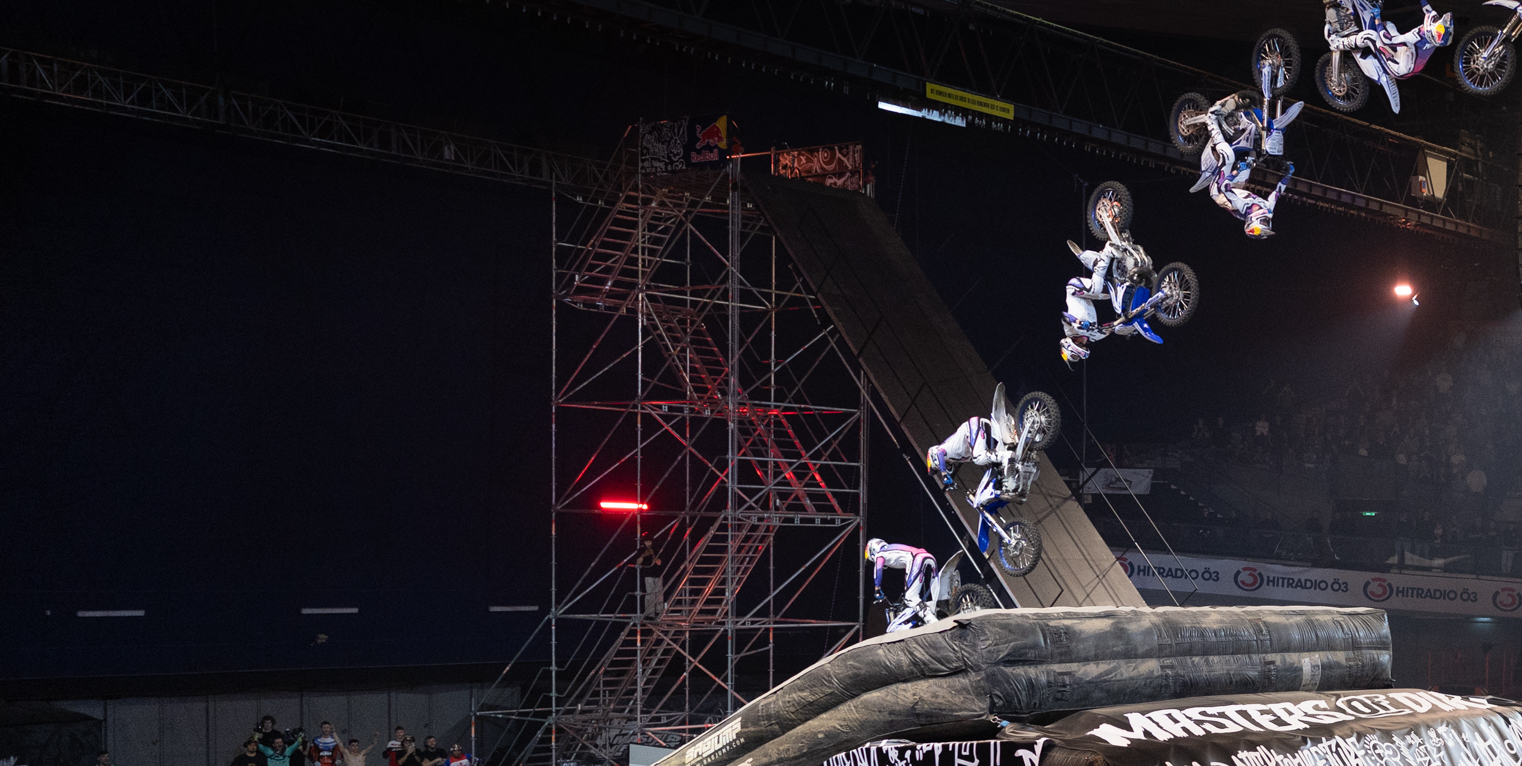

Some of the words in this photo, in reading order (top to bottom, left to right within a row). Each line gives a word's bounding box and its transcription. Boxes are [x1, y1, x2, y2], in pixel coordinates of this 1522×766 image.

[1137, 565, 1199, 580] HITRADIO
[1201, 567, 1220, 582] Ö3
[1266, 575, 1329, 591] HITRADIO
[1331, 578, 1349, 593] Ö3
[1396, 586, 1458, 601] HITRADIO
[1460, 587, 1477, 603] Ö3
[1085, 699, 1355, 747] MASTERS
[1336, 693, 1414, 719] OF
